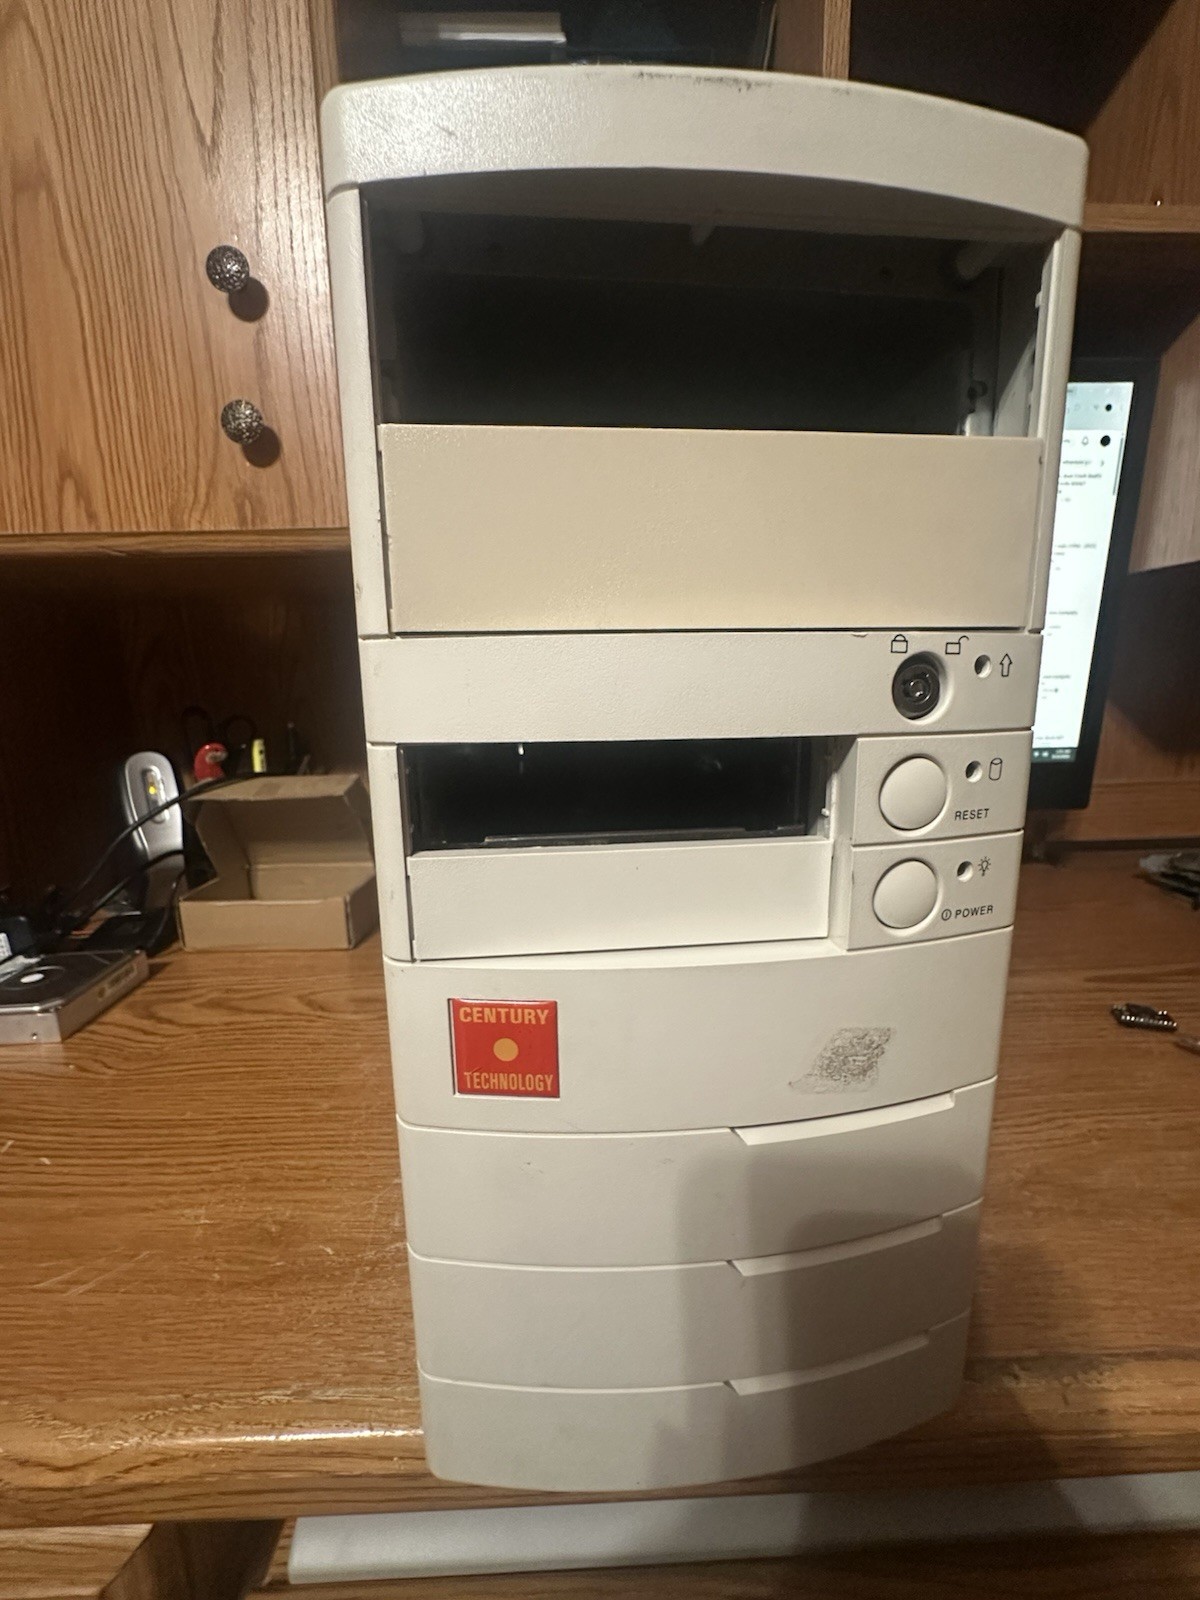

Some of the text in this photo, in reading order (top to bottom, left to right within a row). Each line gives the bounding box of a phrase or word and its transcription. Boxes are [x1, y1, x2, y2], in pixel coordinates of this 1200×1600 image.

[954, 808, 989, 820] RESET
[954, 904, 994, 919] POWER
[459, 1007, 549, 1025] CENTURY
[463, 1071, 554, 1092] TECHNOLOGY
